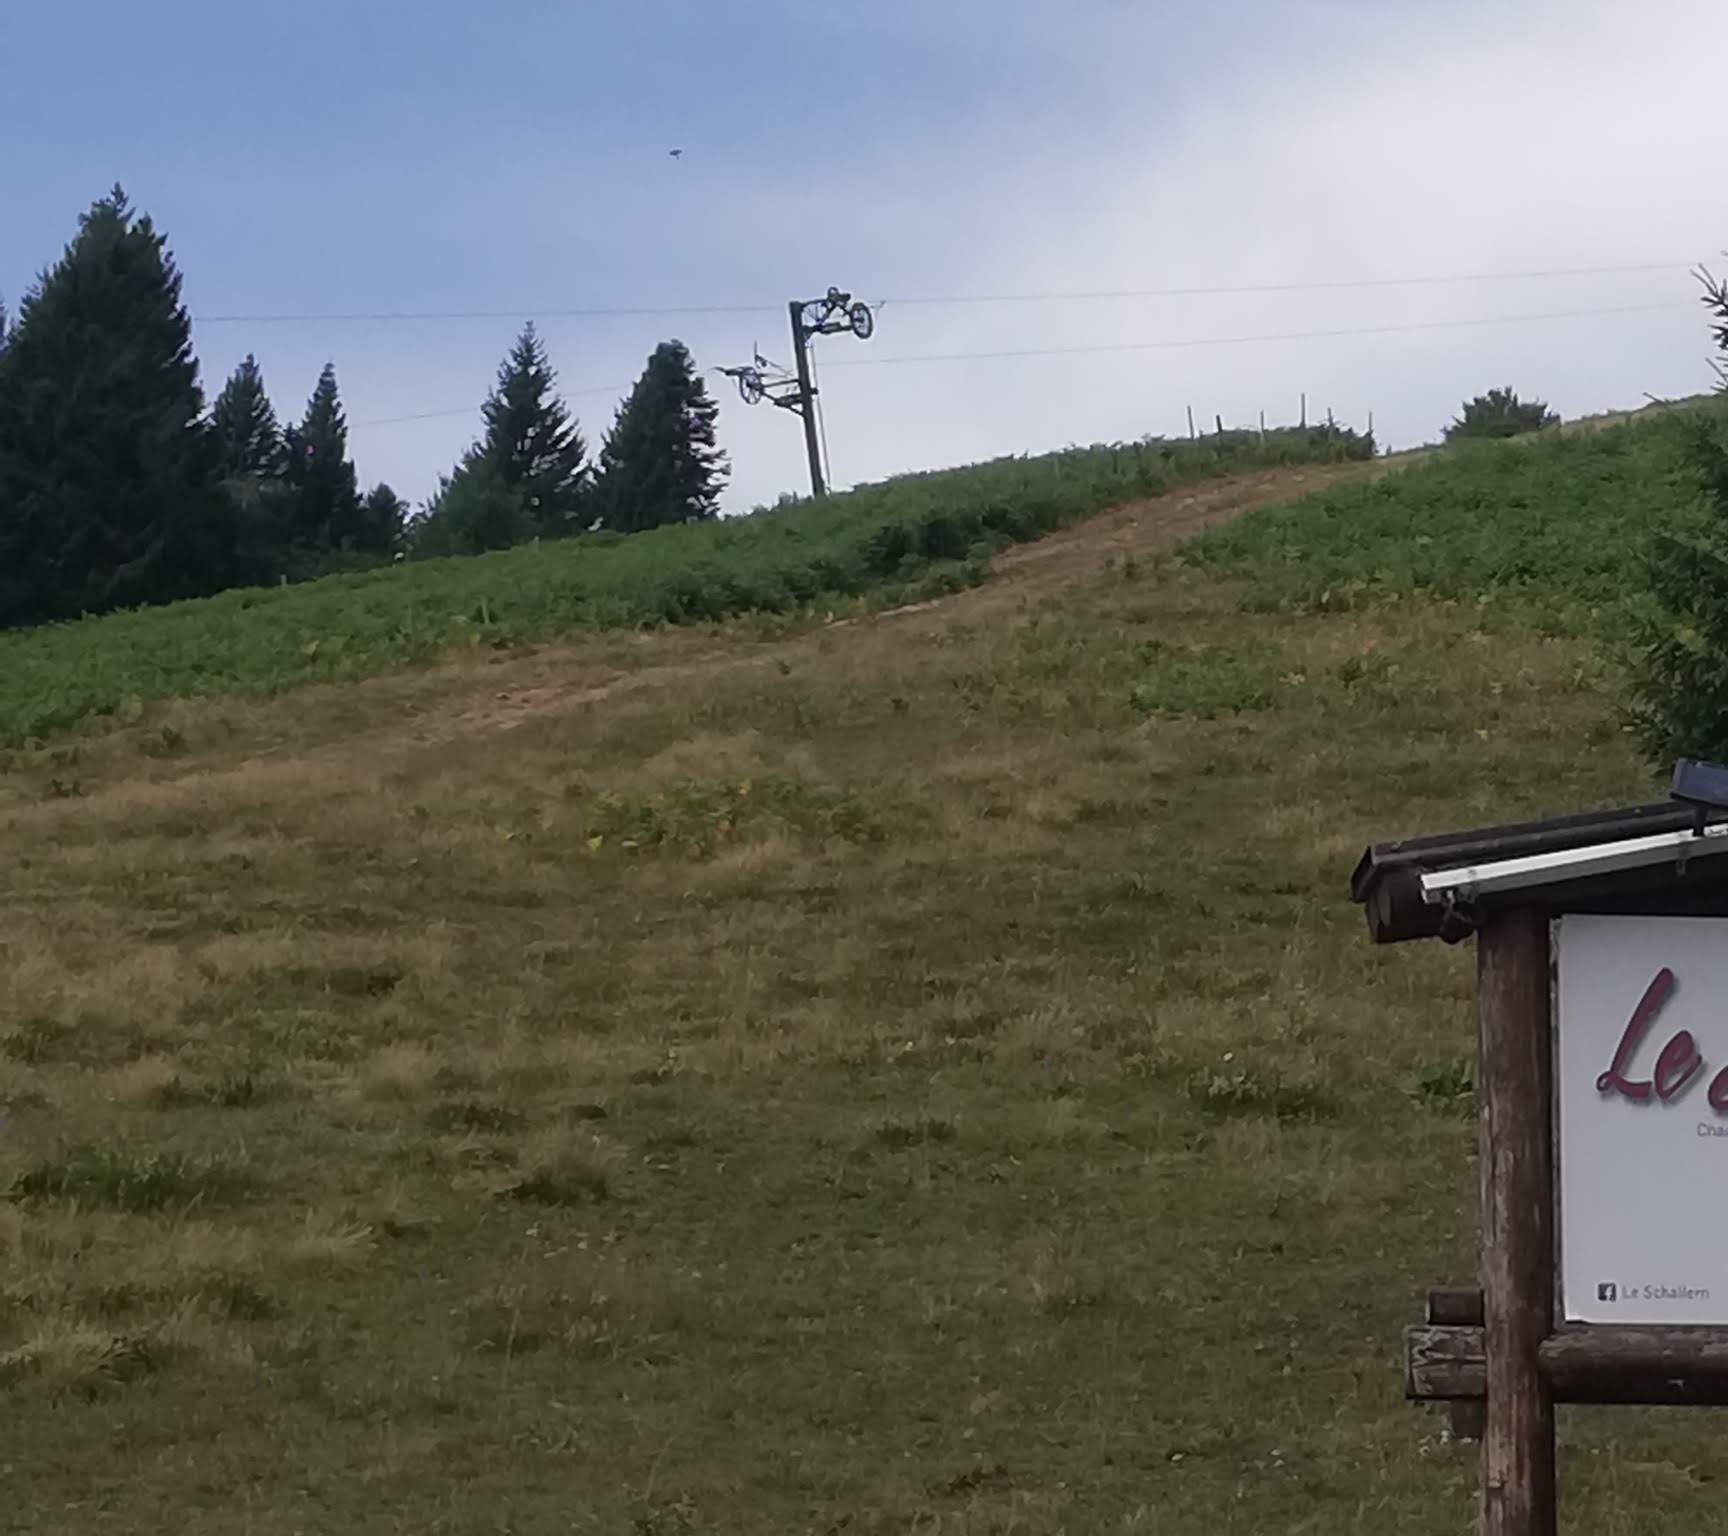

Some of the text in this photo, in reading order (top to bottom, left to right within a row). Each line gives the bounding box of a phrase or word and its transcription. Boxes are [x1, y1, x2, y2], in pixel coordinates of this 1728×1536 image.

[1597, 967, 1702, 1100] Le
[1621, 1285, 1639, 1300] Le
[1643, 1284, 1710, 1301] Schallern
